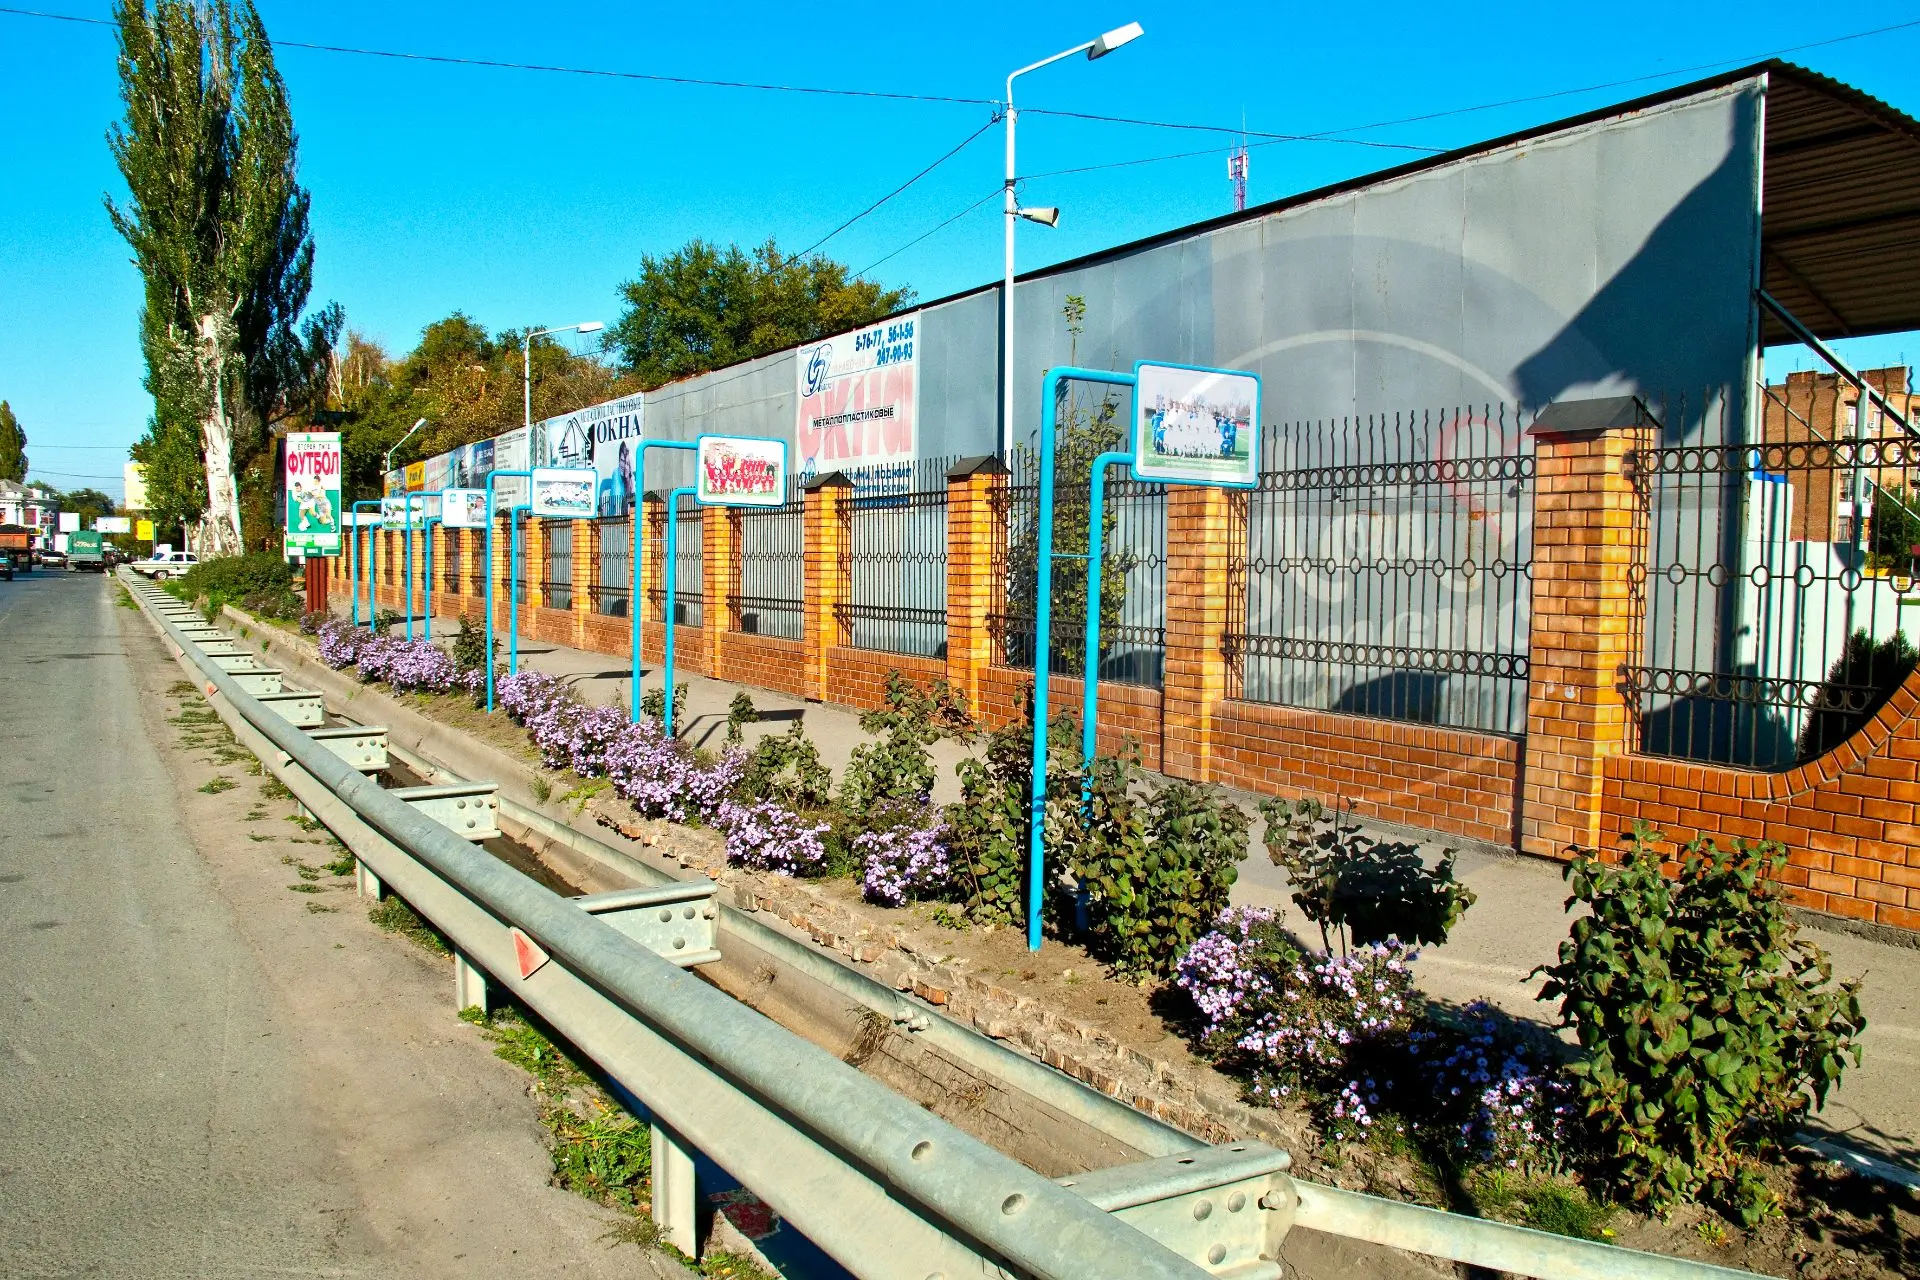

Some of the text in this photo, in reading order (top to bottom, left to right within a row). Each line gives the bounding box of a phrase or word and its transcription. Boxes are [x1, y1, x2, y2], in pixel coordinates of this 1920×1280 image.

[888, 321, 914, 344] 56-1-56
[876, 341, 913, 366] 247-90-93
[596, 413, 642, 444] ОКНА
[812, 406, 894, 429] МЕТАЛЛОПЛАСТИКОВЫЕ
[287, 450, 340, 476] ФУТБОЛ
